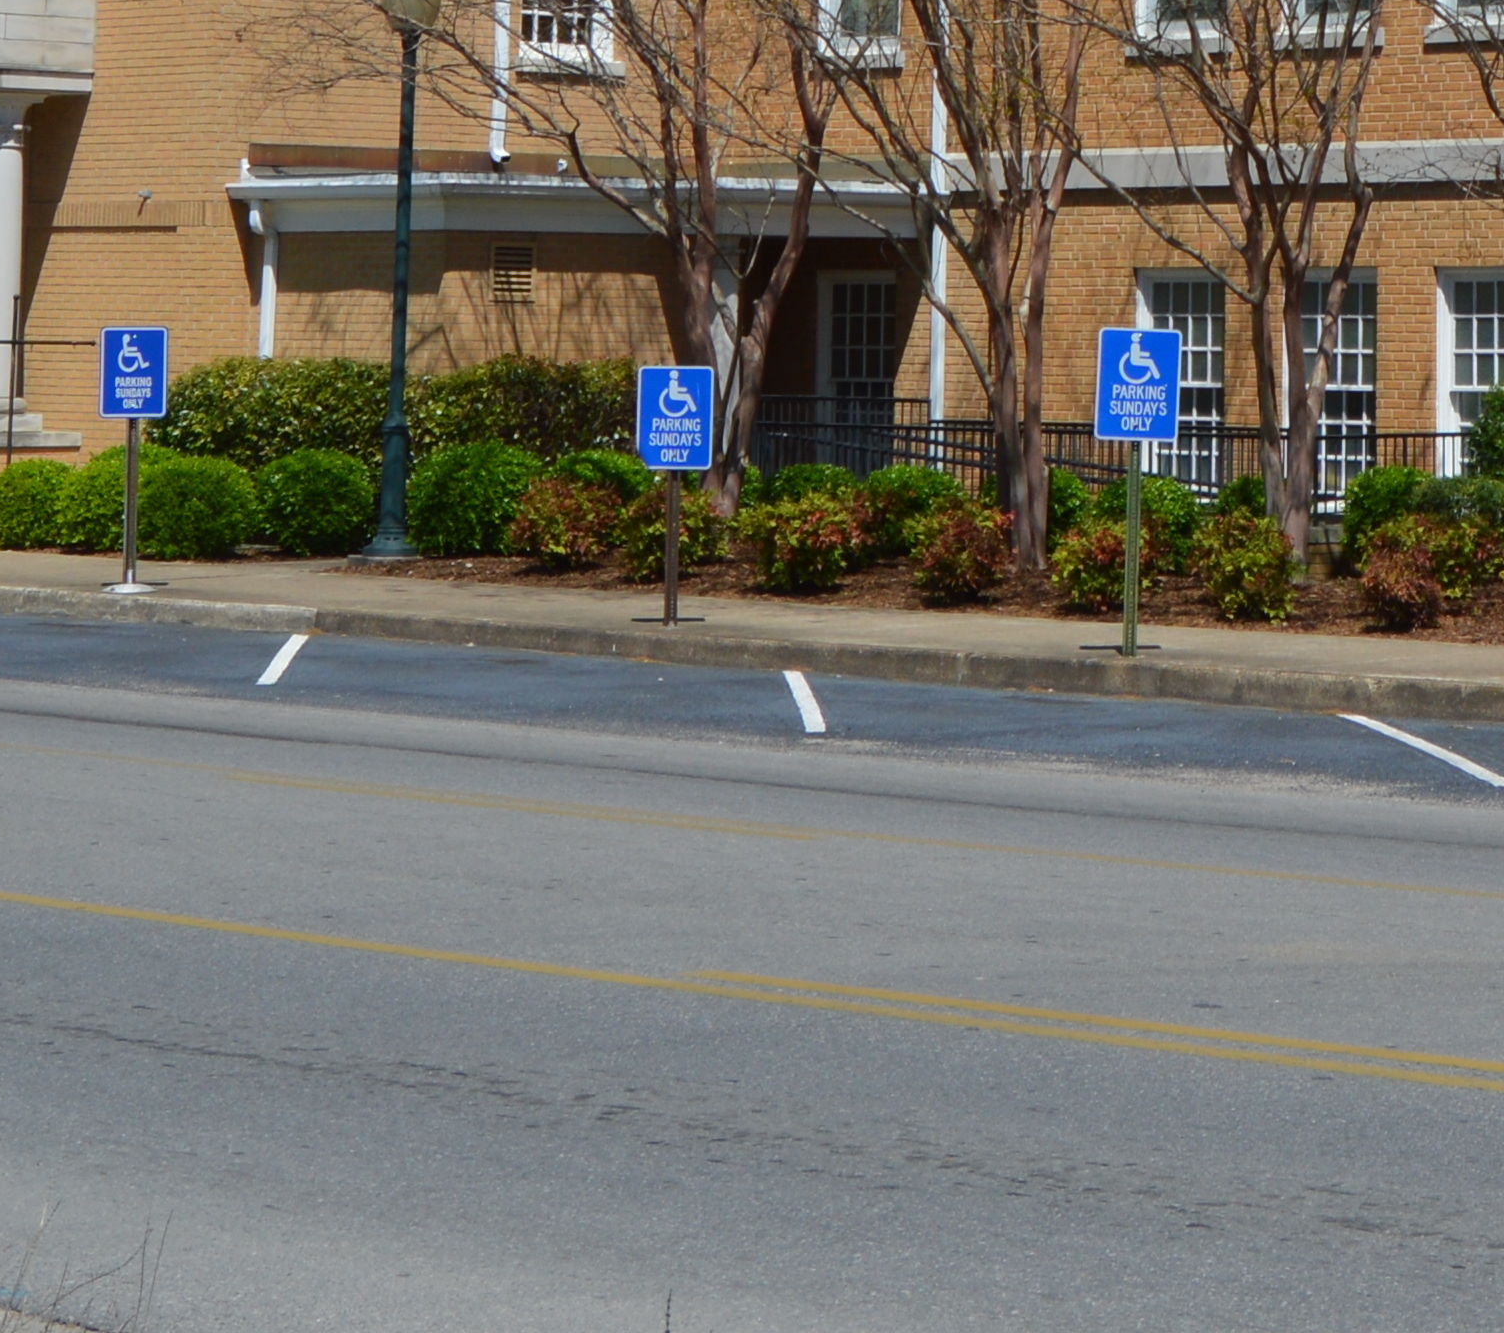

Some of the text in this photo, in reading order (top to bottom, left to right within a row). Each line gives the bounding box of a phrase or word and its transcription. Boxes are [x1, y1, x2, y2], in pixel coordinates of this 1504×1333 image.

[115, 377, 152, 387] PARKING
[115, 388, 151, 398] SUNDAYS
[1112, 385, 1166, 400] PARKING
[1109, 401, 1167, 416] SUNDAYS
[652, 418, 701, 431] PARKING
[1121, 417, 1153, 431] ONLY
[649, 433, 701, 446] SUNDAYS
[660, 449, 689, 462] ONLY
